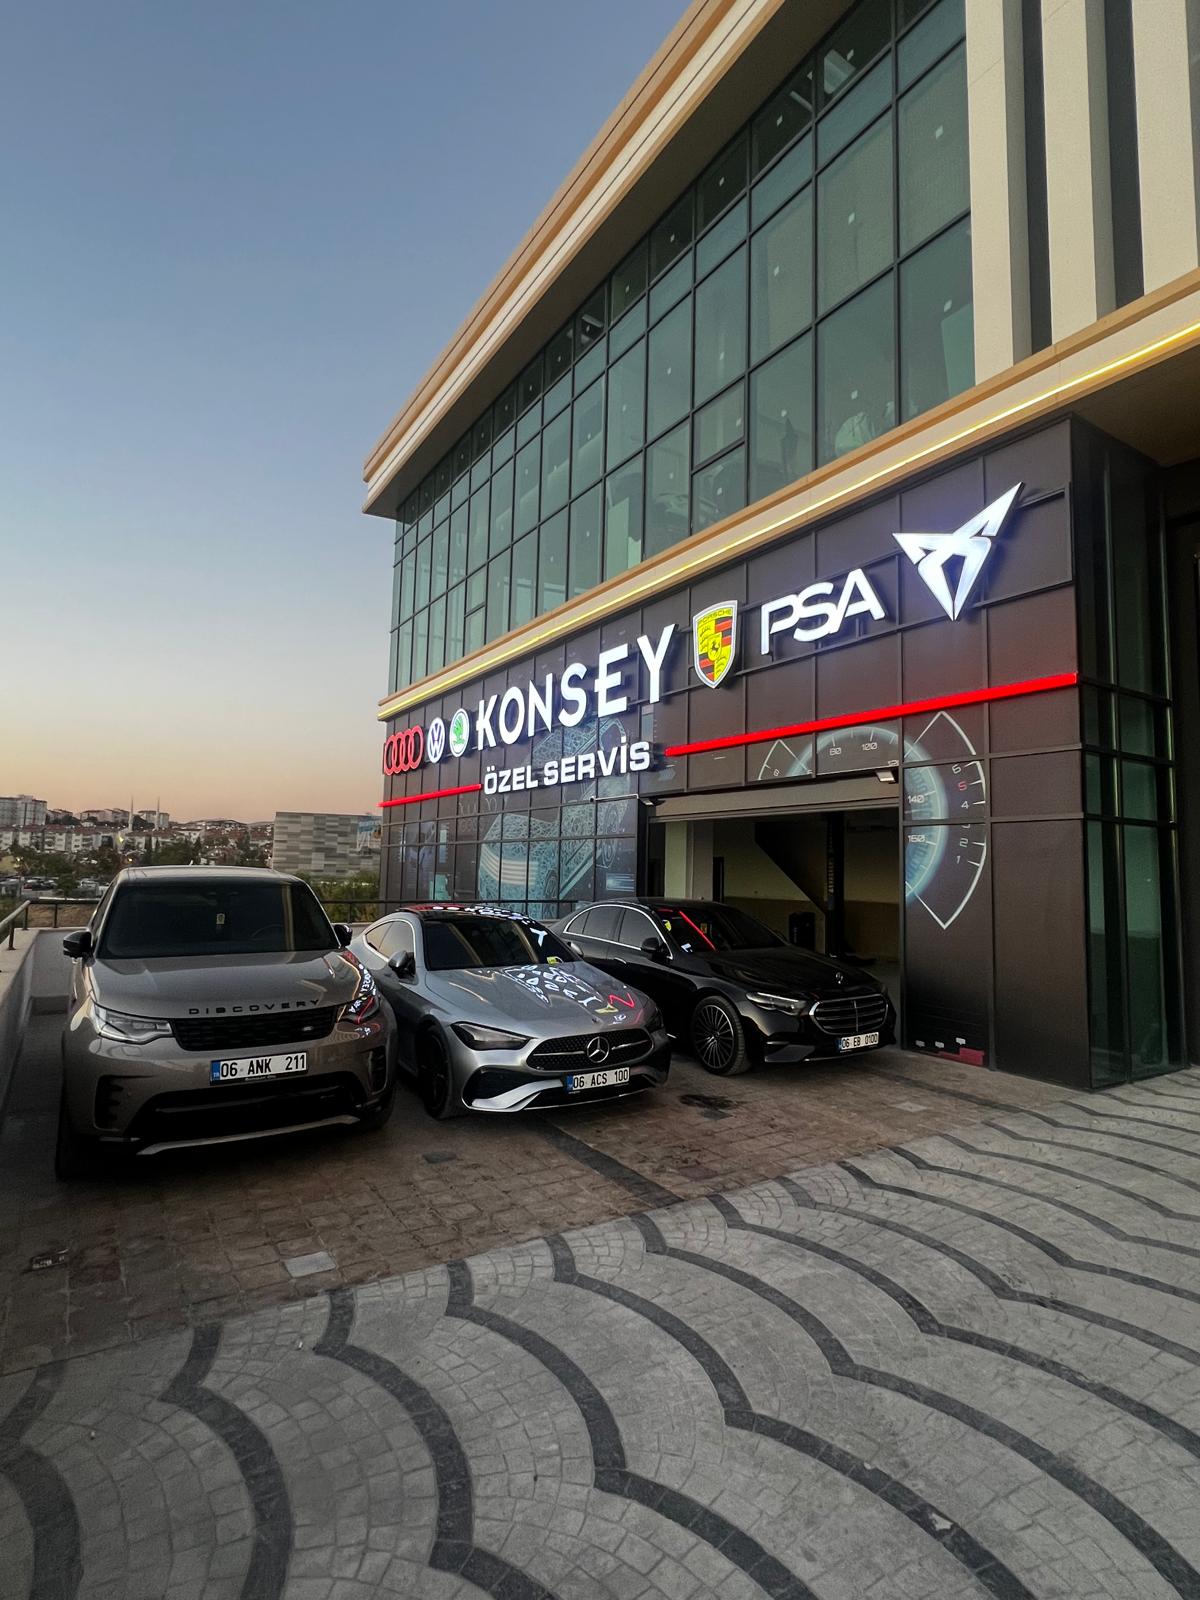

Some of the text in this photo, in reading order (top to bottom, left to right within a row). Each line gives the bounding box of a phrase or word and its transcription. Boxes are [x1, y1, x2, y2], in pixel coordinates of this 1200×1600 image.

[761, 568, 886, 655] PSA
[476, 624, 678, 750] KONSEY
[862, 742, 878, 751] 100
[484, 736, 650, 795] ÖZEL SERVİS
[908, 795, 925, 804] 140
[961, 801, 969, 809] 4
[960, 838, 969, 847] 2
[188, 999, 319, 1015] DISCOVERY
[221, 1062, 238, 1078] 06
[247, 1058, 272, 1075] ANK
[285, 1055, 305, 1071] 211
[573, 1069, 629, 1089] 06 ACS 100
